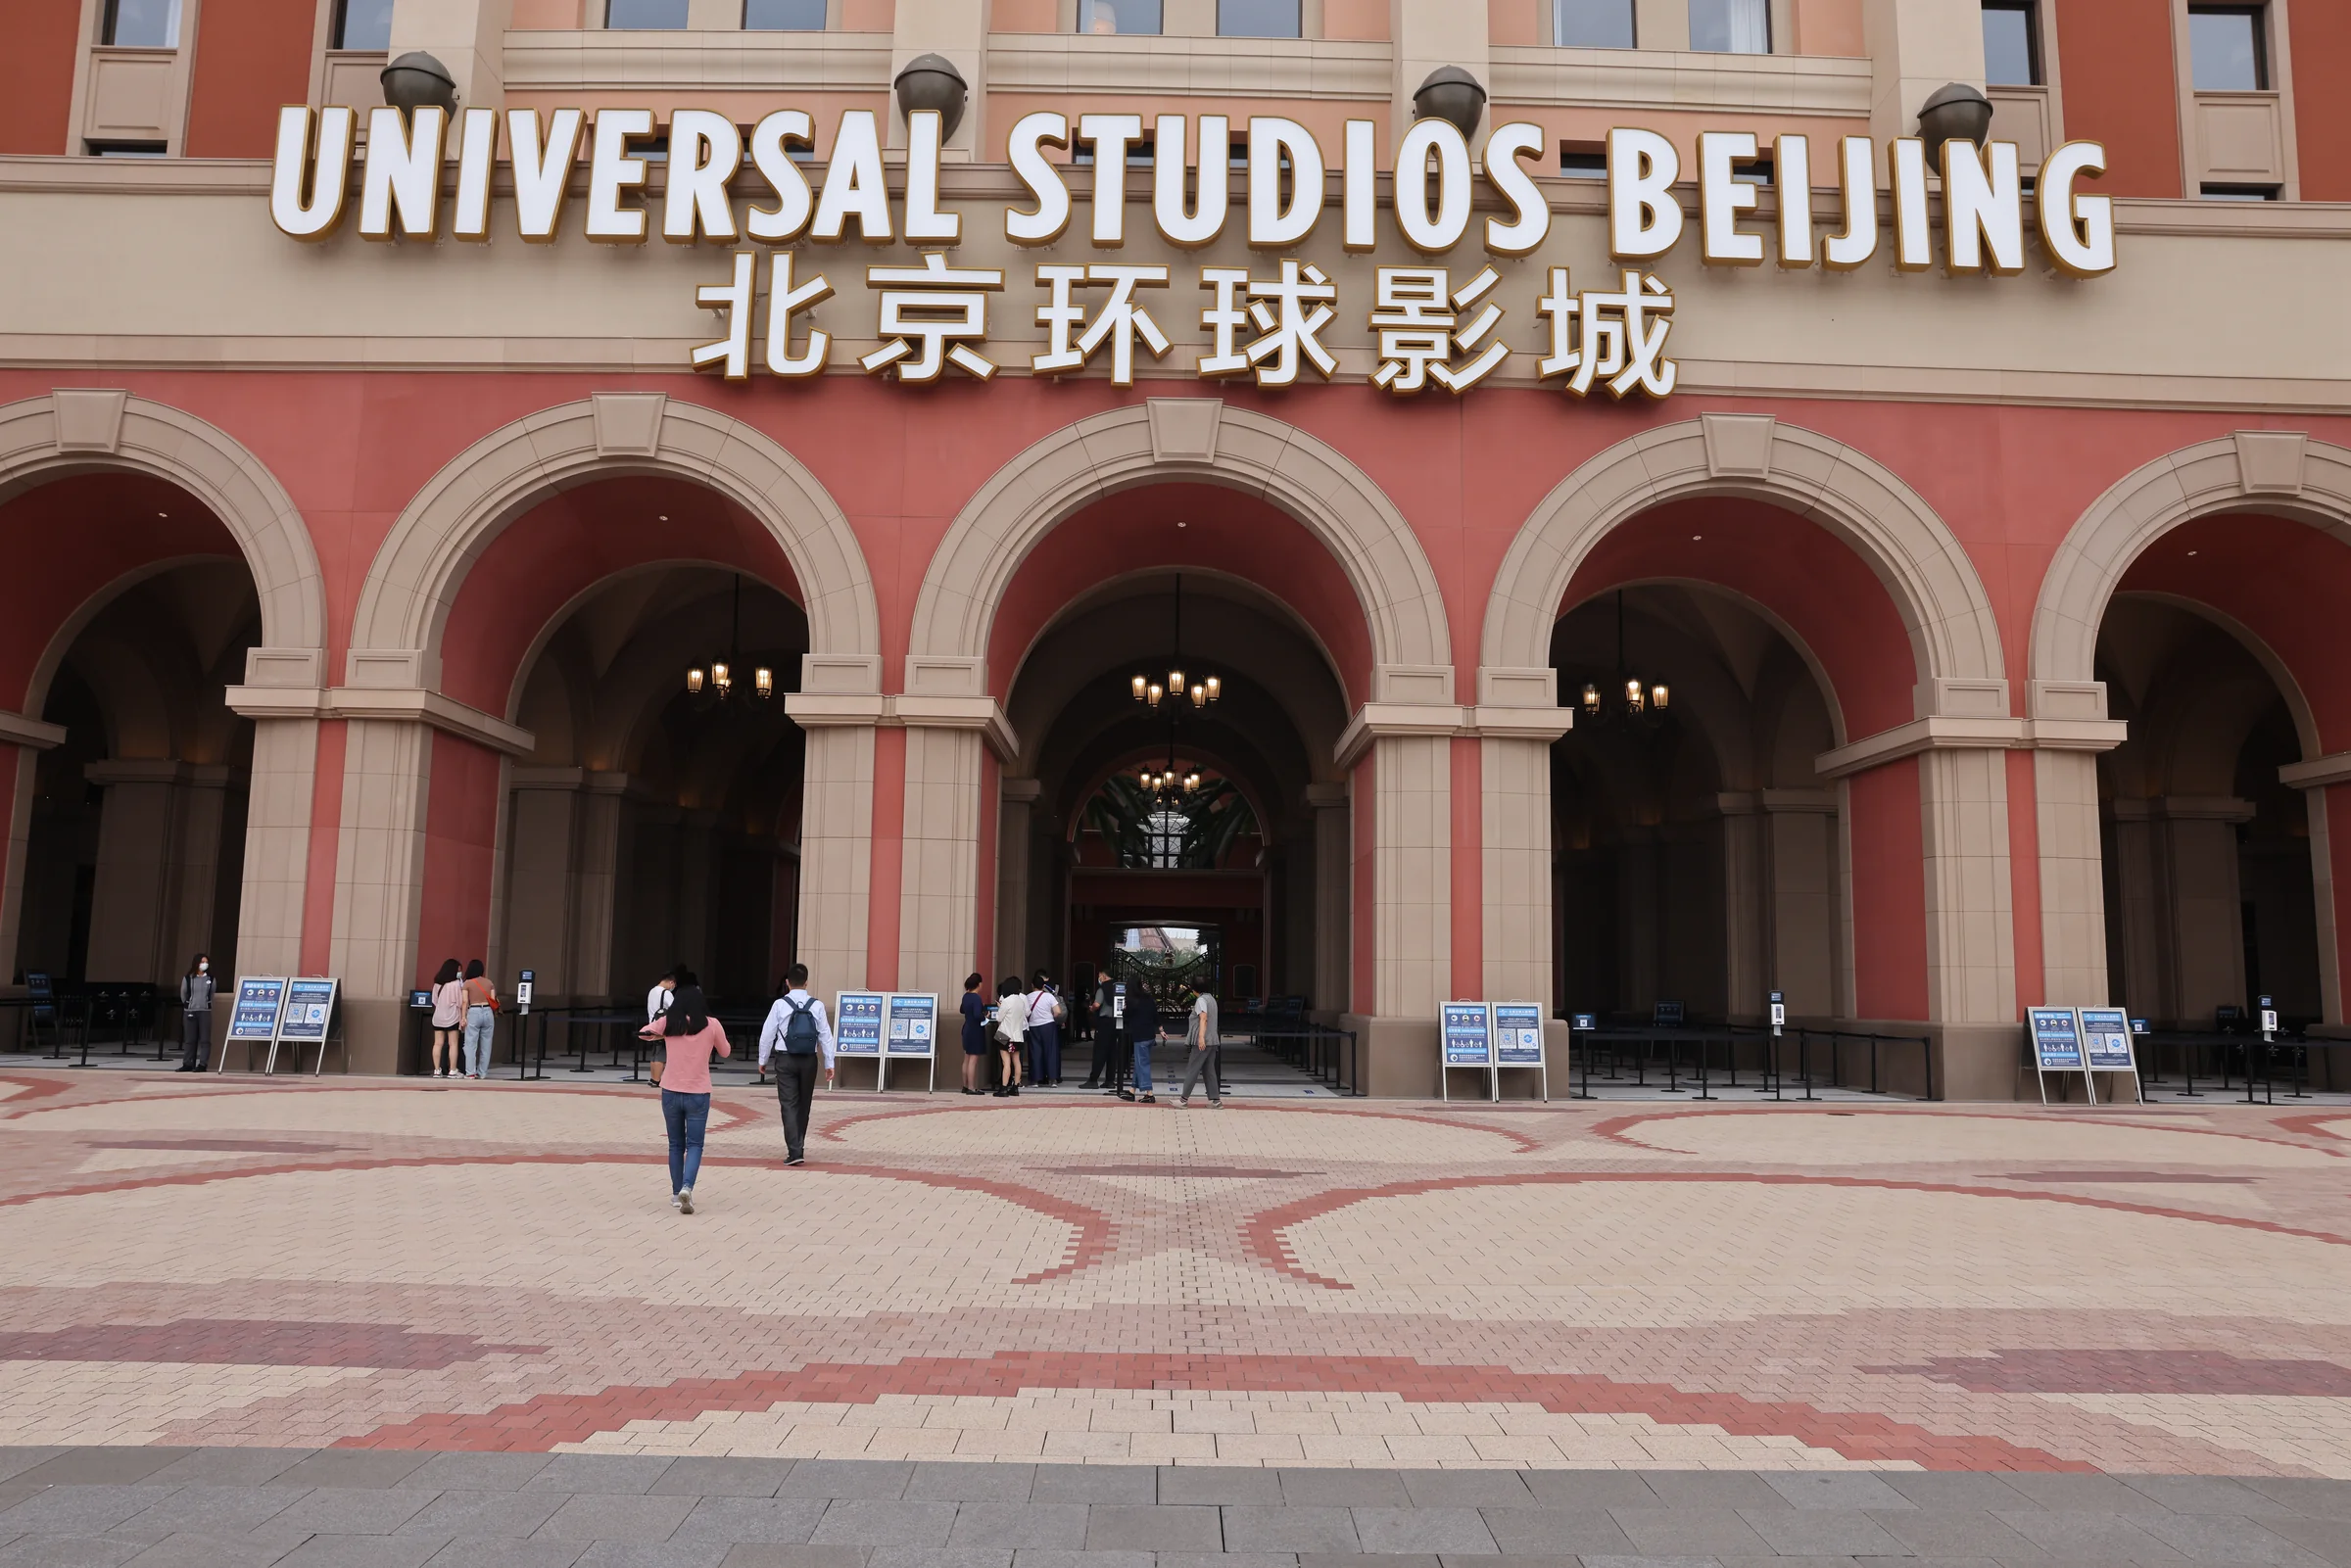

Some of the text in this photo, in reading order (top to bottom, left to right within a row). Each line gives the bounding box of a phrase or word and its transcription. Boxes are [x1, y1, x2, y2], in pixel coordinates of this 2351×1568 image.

[269, 104, 2117, 279] UNIVERSAL STUDIOS BEIJING
[690, 251, 1679, 400] 北京环球影城
